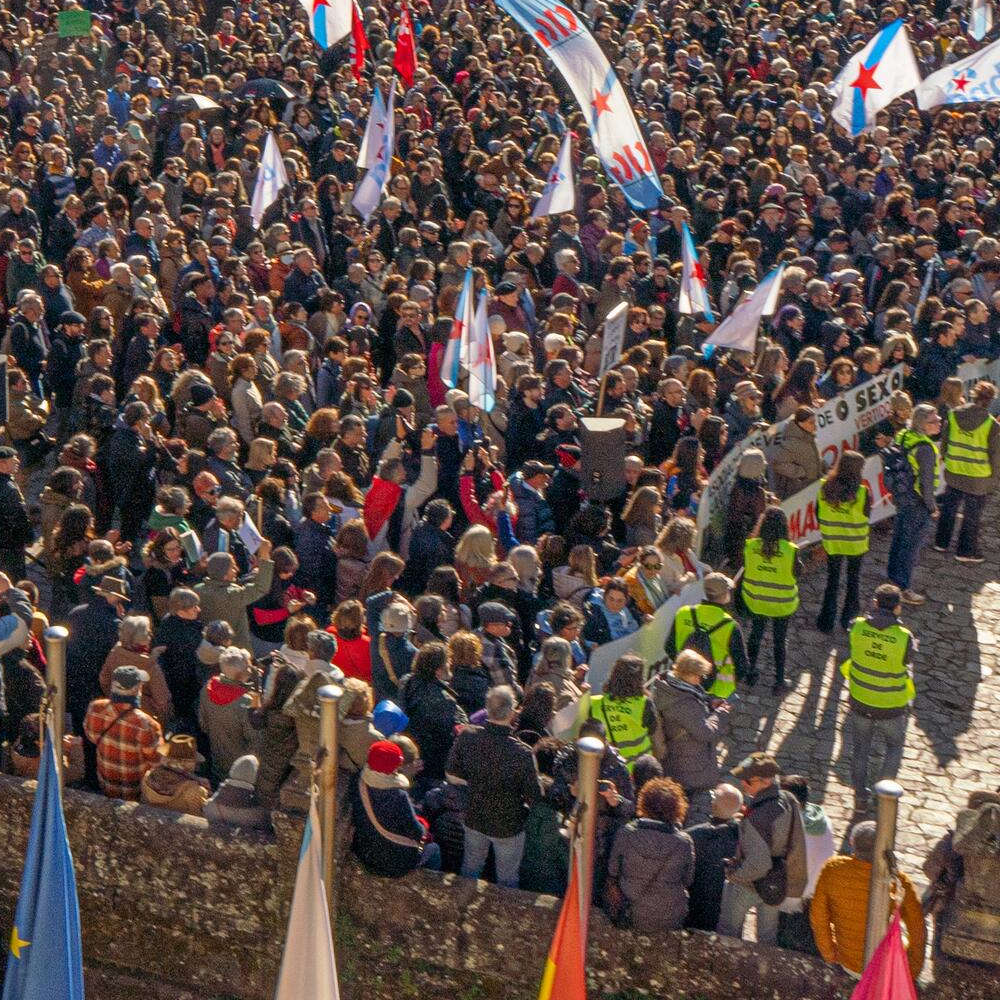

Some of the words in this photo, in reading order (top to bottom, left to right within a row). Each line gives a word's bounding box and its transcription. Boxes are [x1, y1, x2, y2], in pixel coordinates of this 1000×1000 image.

[817, 410, 834, 428] DE
[855, 372, 900, 412] SEXO
[862, 629, 897, 644] SERVIZO
[872, 642, 882, 650] DE
[864, 649, 888, 661] ORDE
[611, 723, 628, 732] RDE
